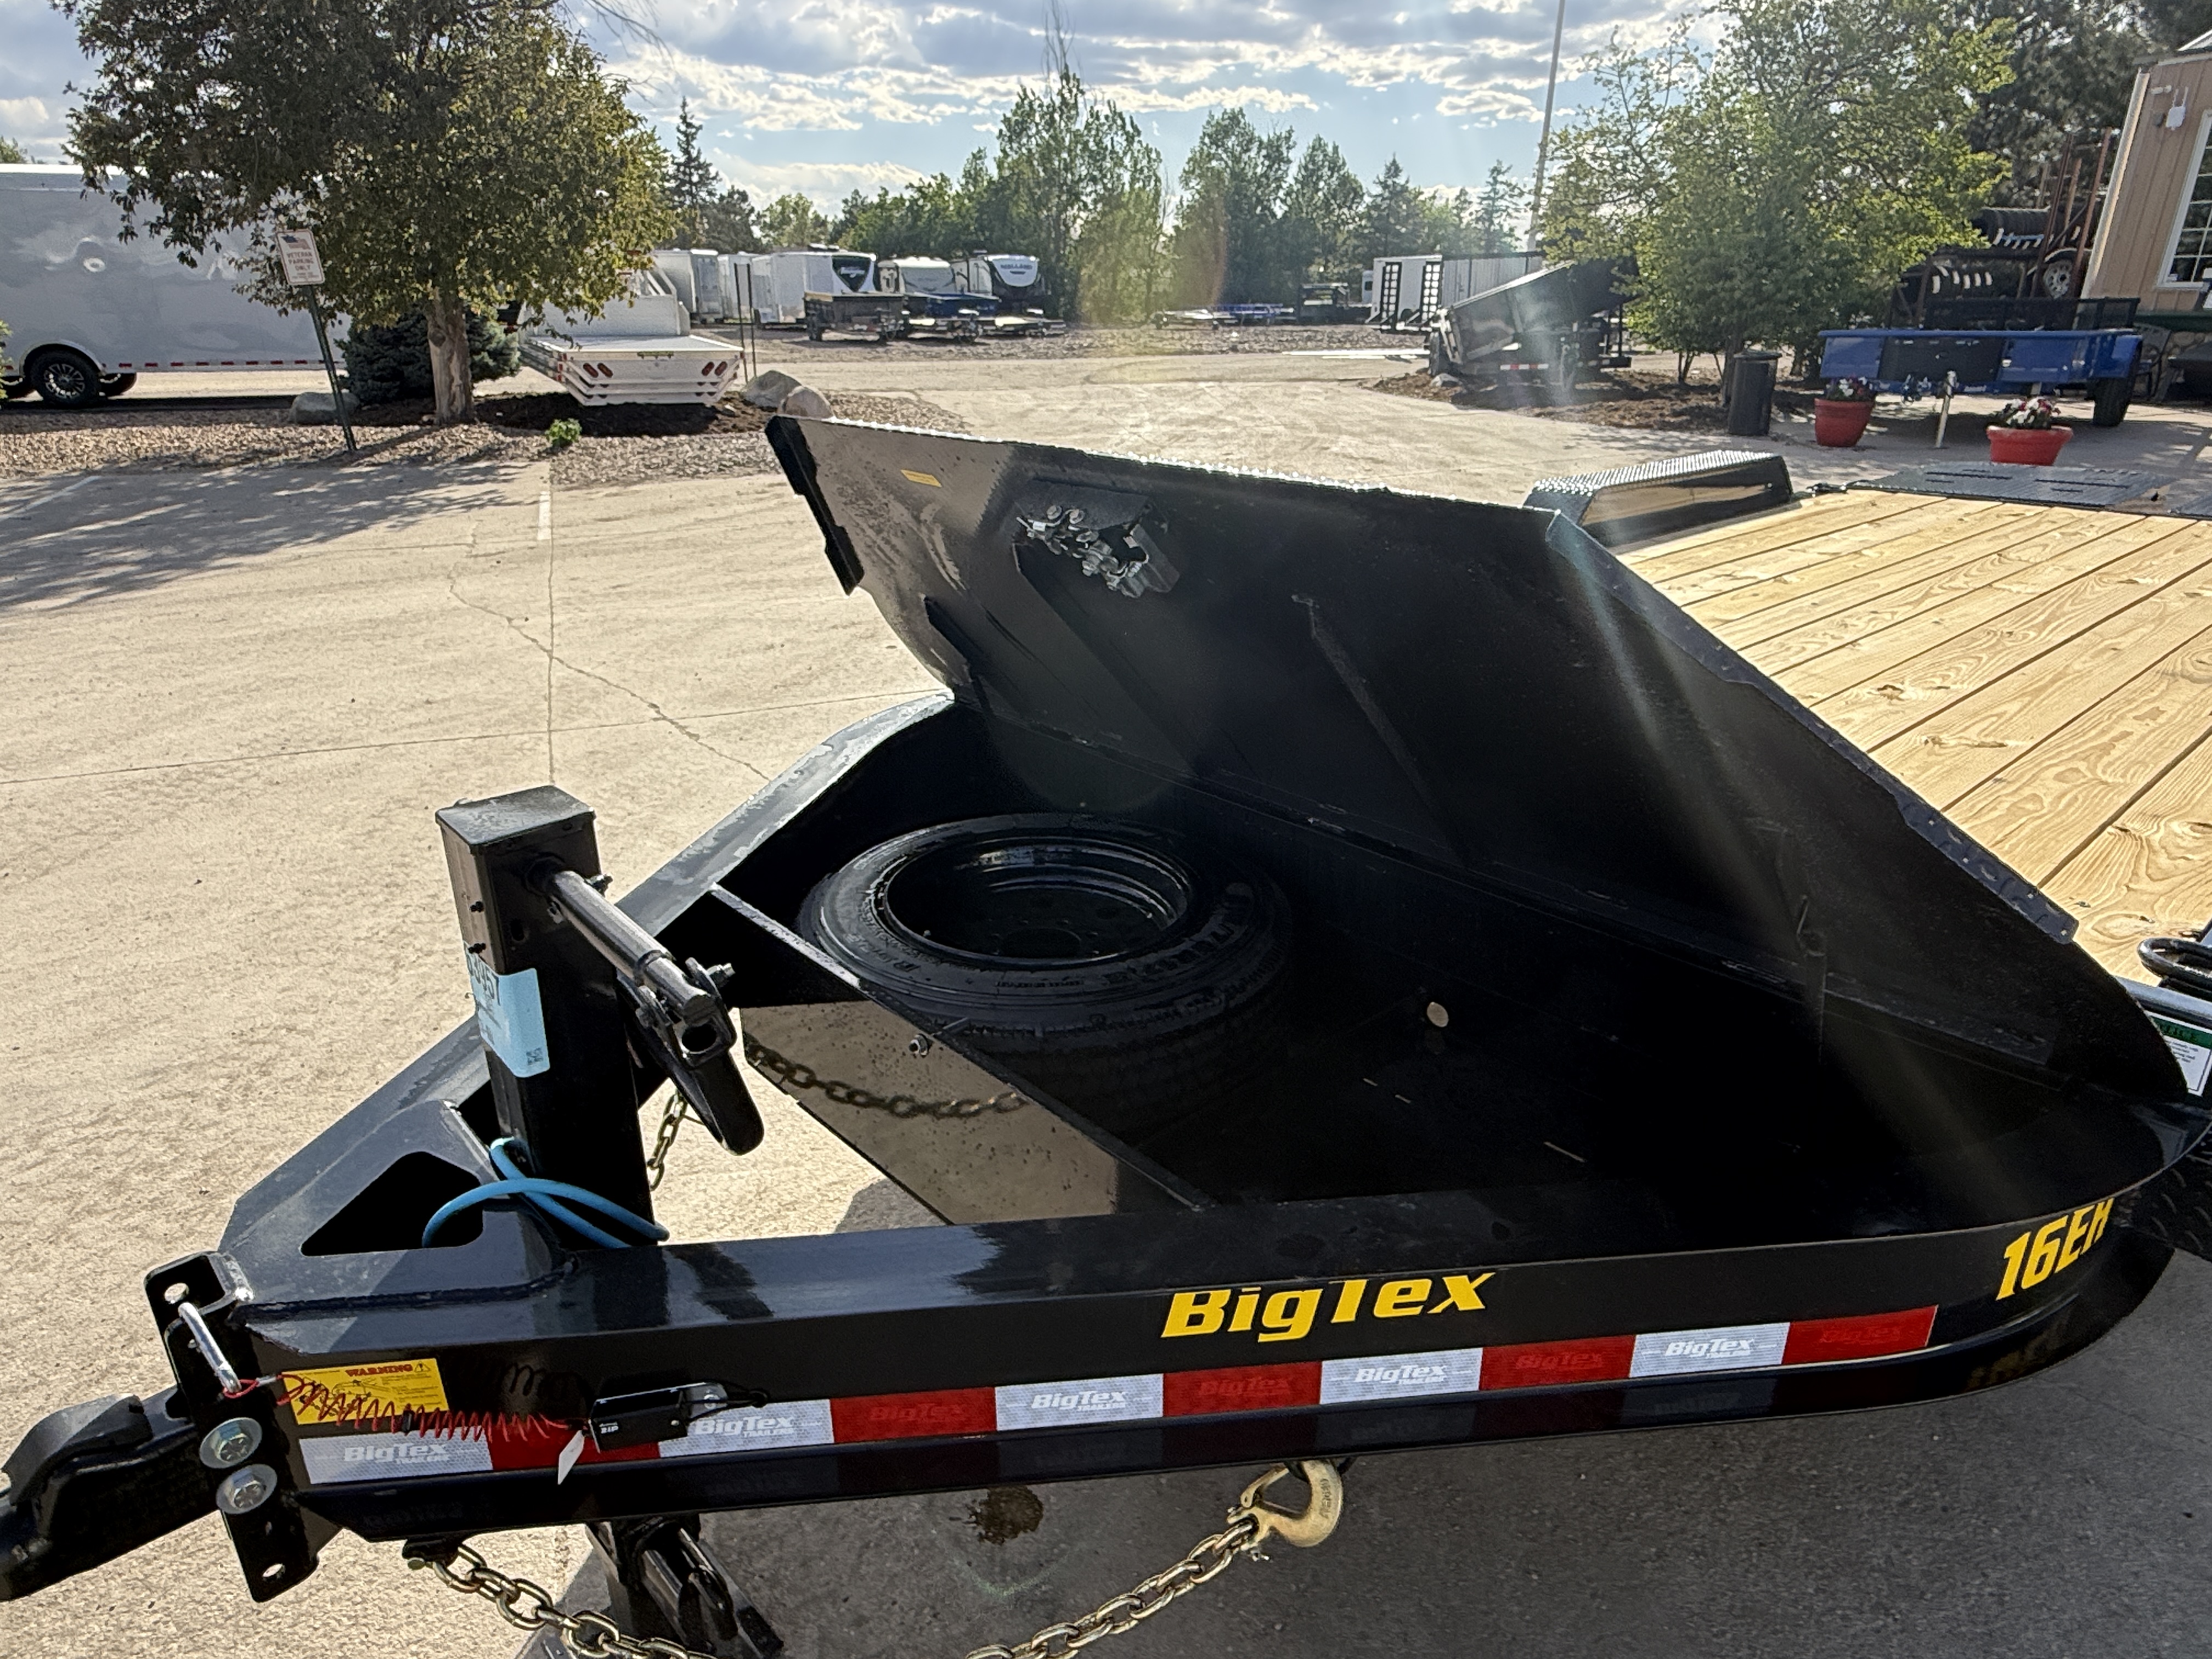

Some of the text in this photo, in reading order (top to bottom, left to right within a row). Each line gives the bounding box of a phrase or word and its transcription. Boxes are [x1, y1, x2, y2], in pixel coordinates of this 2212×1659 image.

[1995, 1197, 2114, 1301] 16EH
[1664, 1338, 1754, 1357] BigTex
[345, 1364, 413, 1376] WARNING
[1354, 1364, 1448, 1384] BigTex
[1031, 1390, 1128, 1411] BigTex
[693, 1415, 795, 1436] BigTex
[344, 1443, 448, 1464] BigTex
